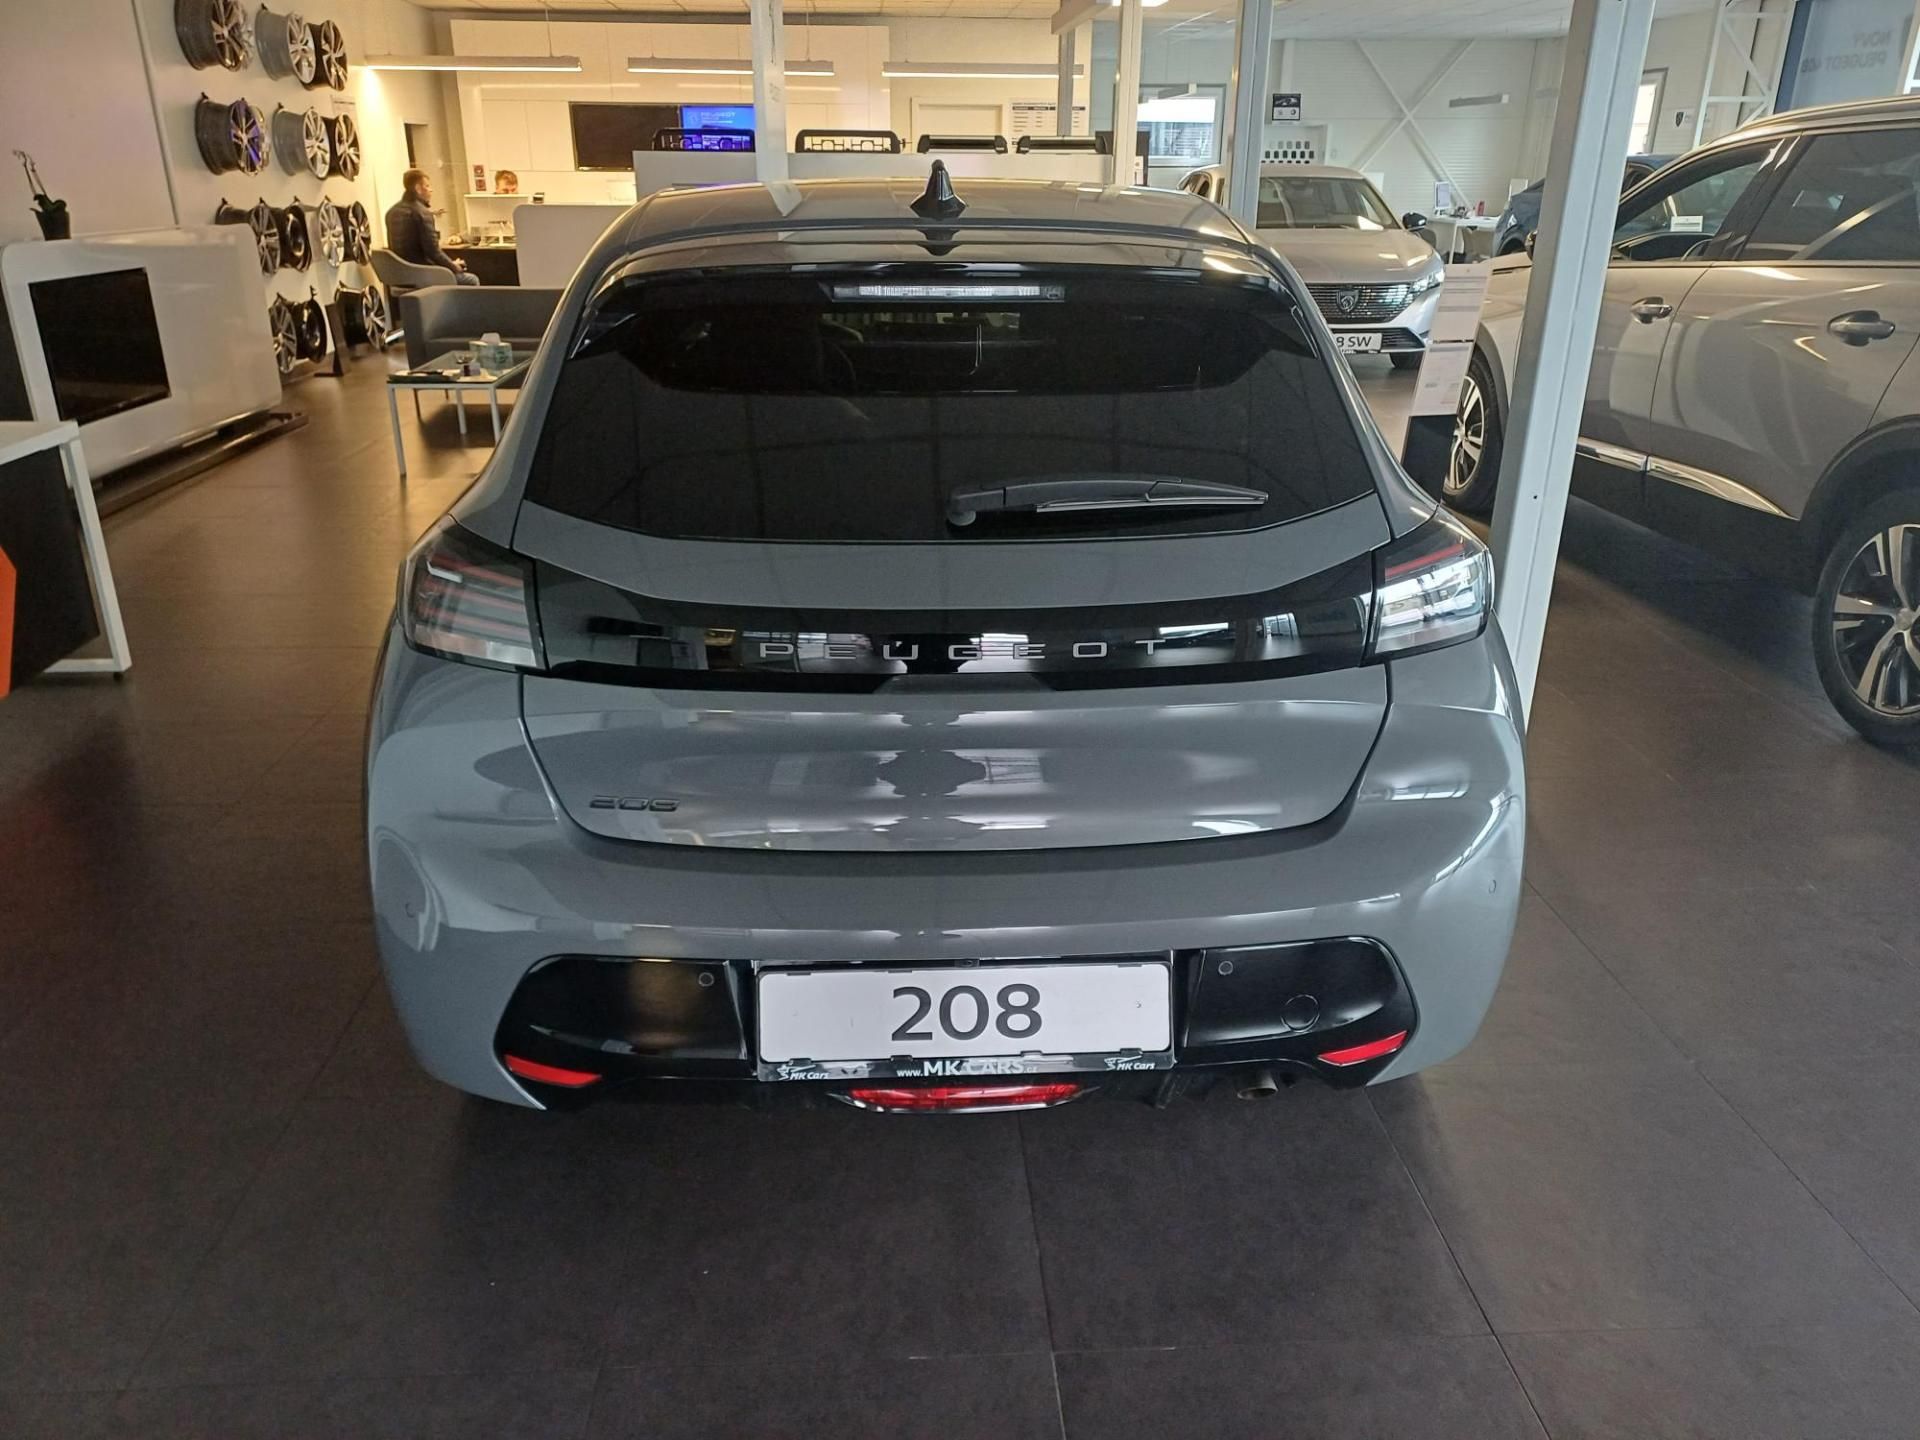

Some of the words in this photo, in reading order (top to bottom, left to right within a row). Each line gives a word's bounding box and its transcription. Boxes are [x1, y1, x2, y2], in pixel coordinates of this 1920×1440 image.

[1347, 336, 1372, 347] SW
[759, 639, 1166, 660] PEUGEOT
[589, 795, 680, 812] 208
[891, 983, 1042, 1041] 208
[790, 1072, 806, 1080] MK
[807, 1071, 829, 1080] Cars
